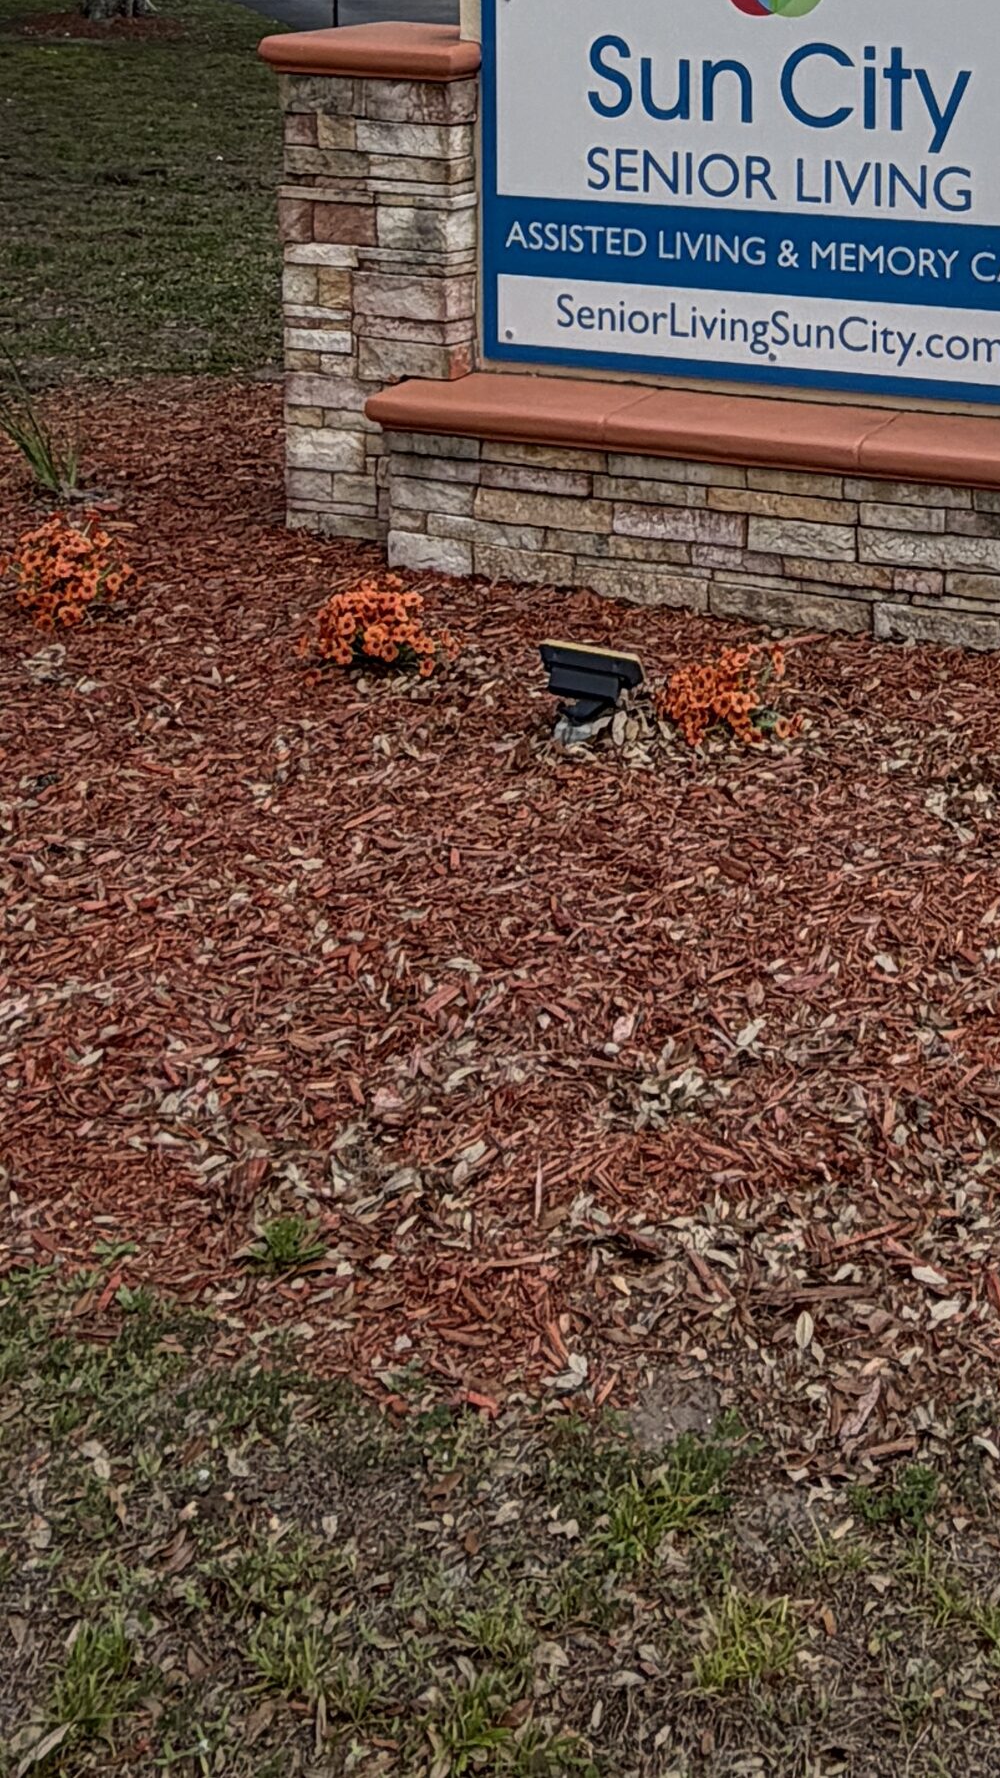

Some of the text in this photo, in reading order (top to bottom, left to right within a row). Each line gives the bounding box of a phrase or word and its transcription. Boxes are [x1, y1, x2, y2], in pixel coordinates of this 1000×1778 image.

[587, 34, 972, 154] Sun City
[586, 146, 973, 212] SENIOR LIVING
[505, 221, 647, 257] ASSISTED
[658, 230, 767, 266] LIVING
[776, 239, 800, 268] &
[811, 240, 960, 279] MEMORY
